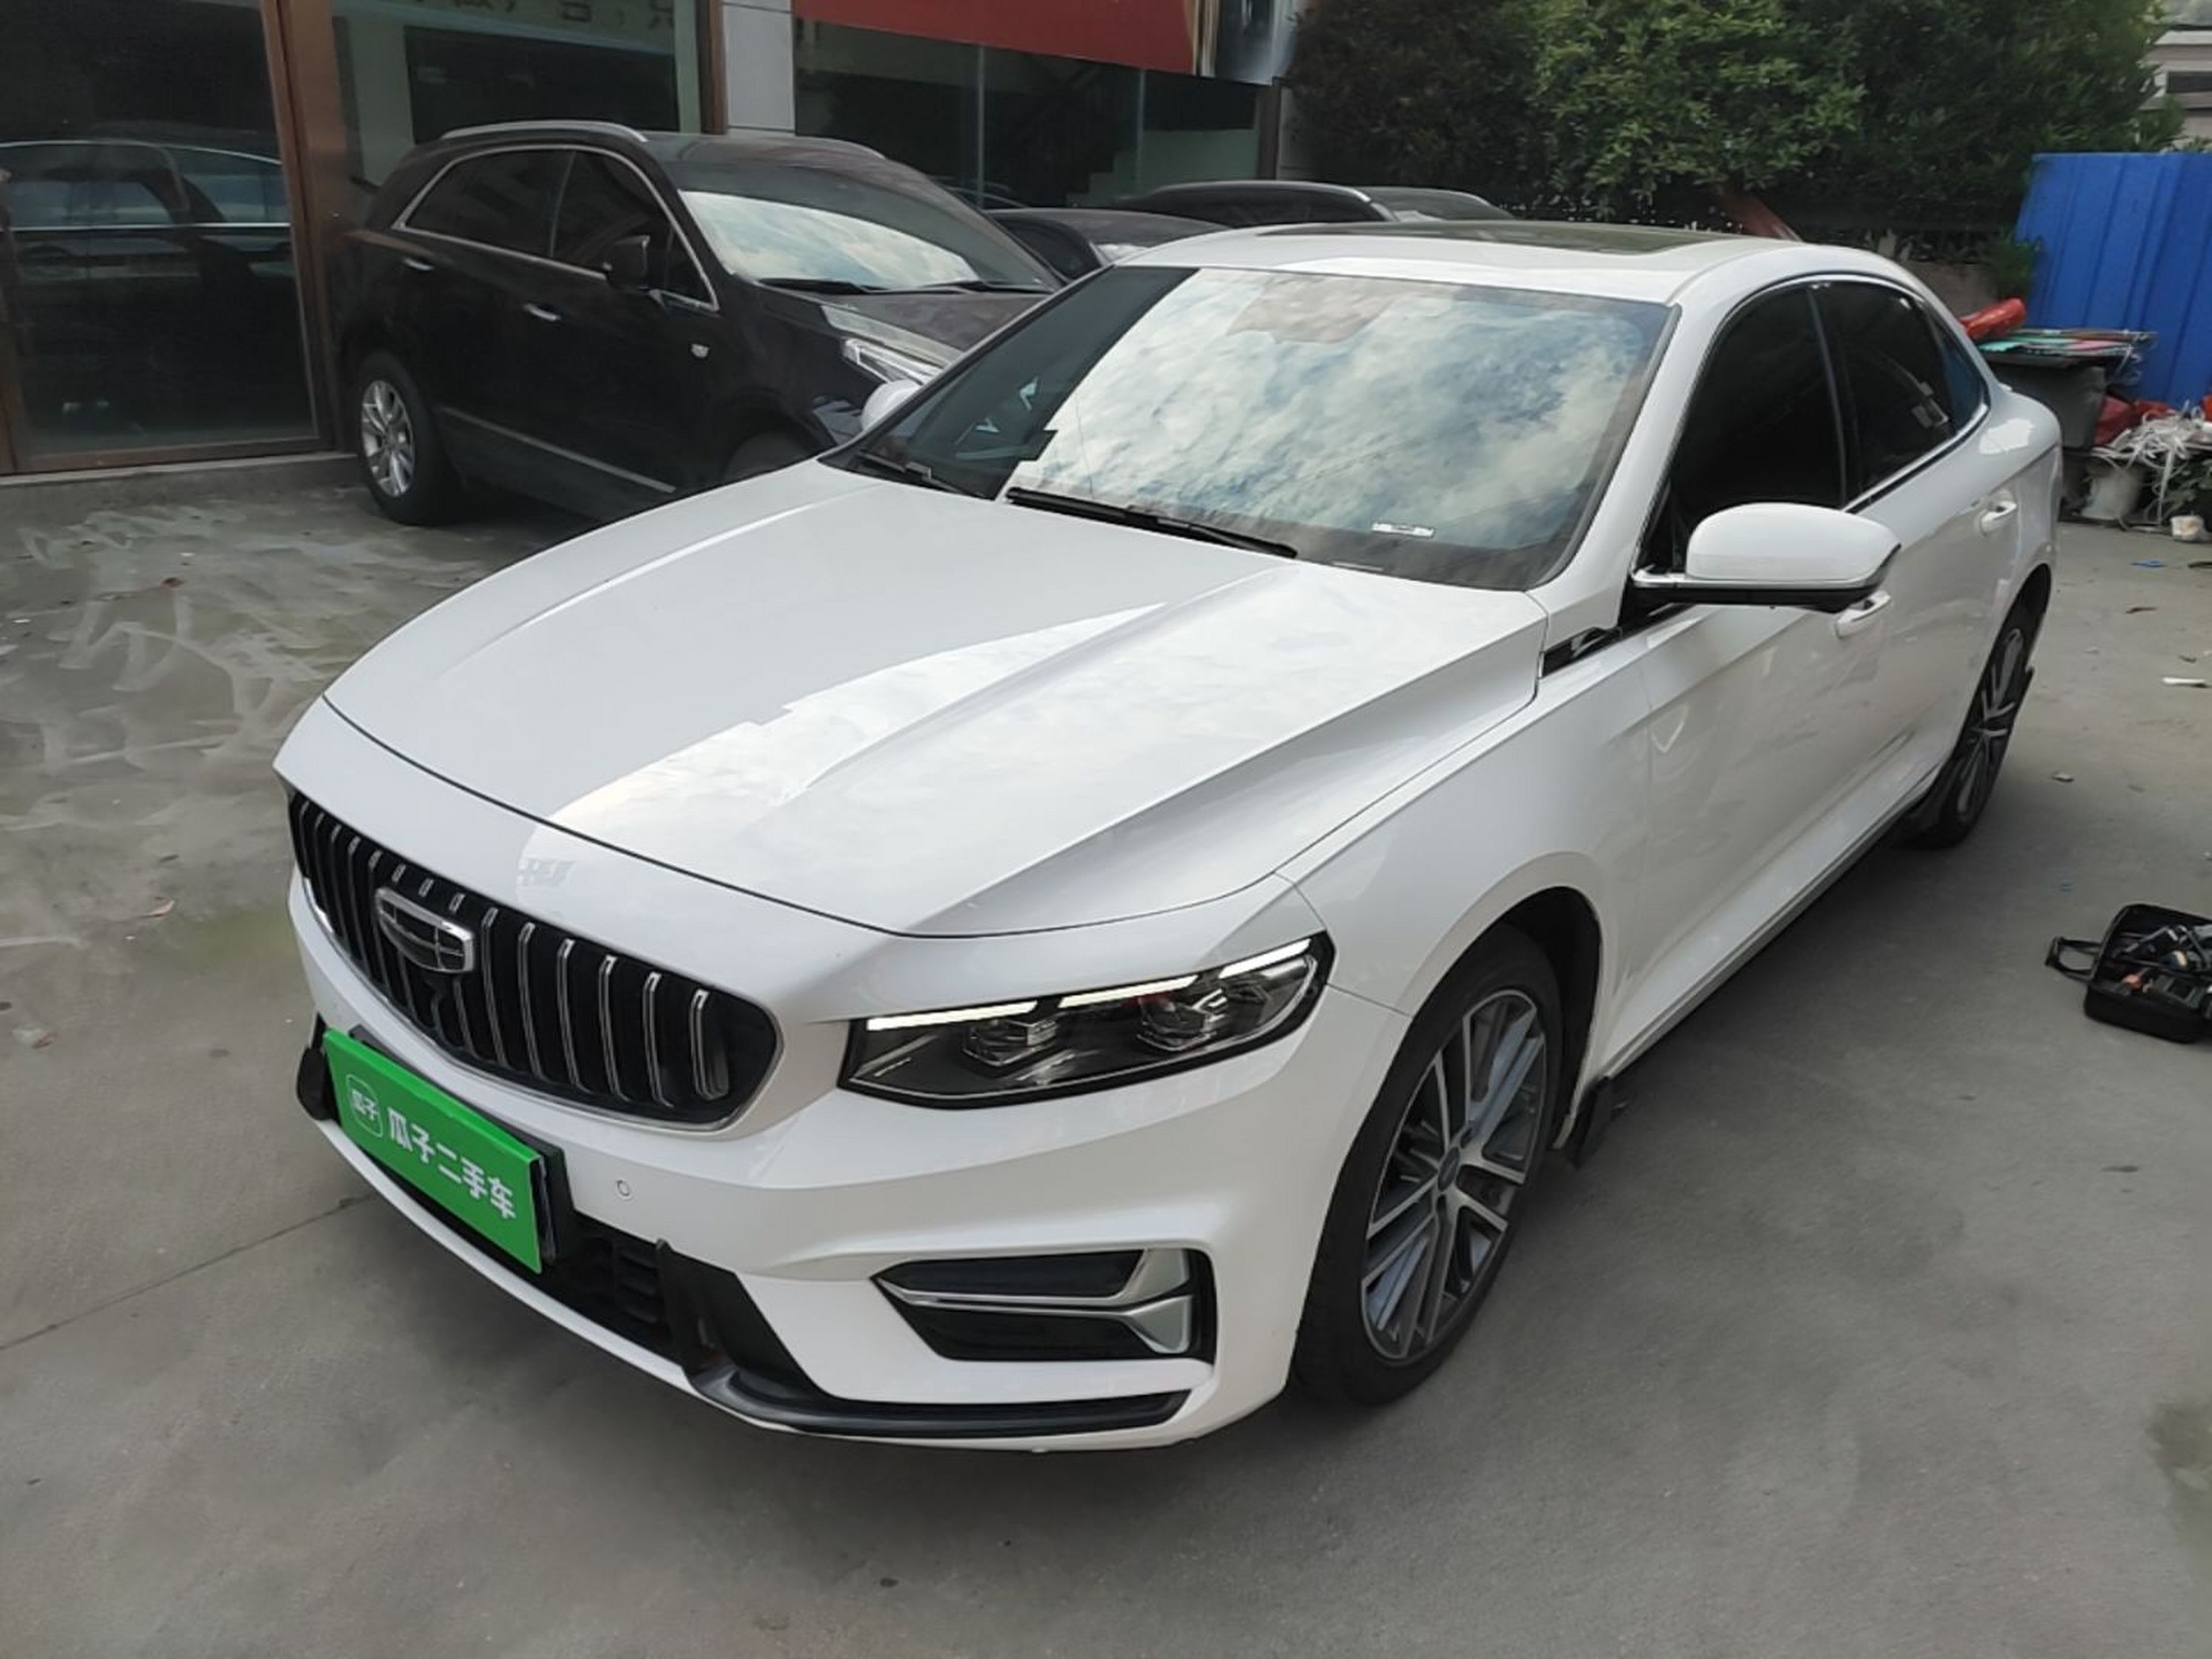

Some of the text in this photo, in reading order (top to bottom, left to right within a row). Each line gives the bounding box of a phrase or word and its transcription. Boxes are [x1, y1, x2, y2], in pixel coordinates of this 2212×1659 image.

[388, 1108, 516, 1219] 瓜子二手车
